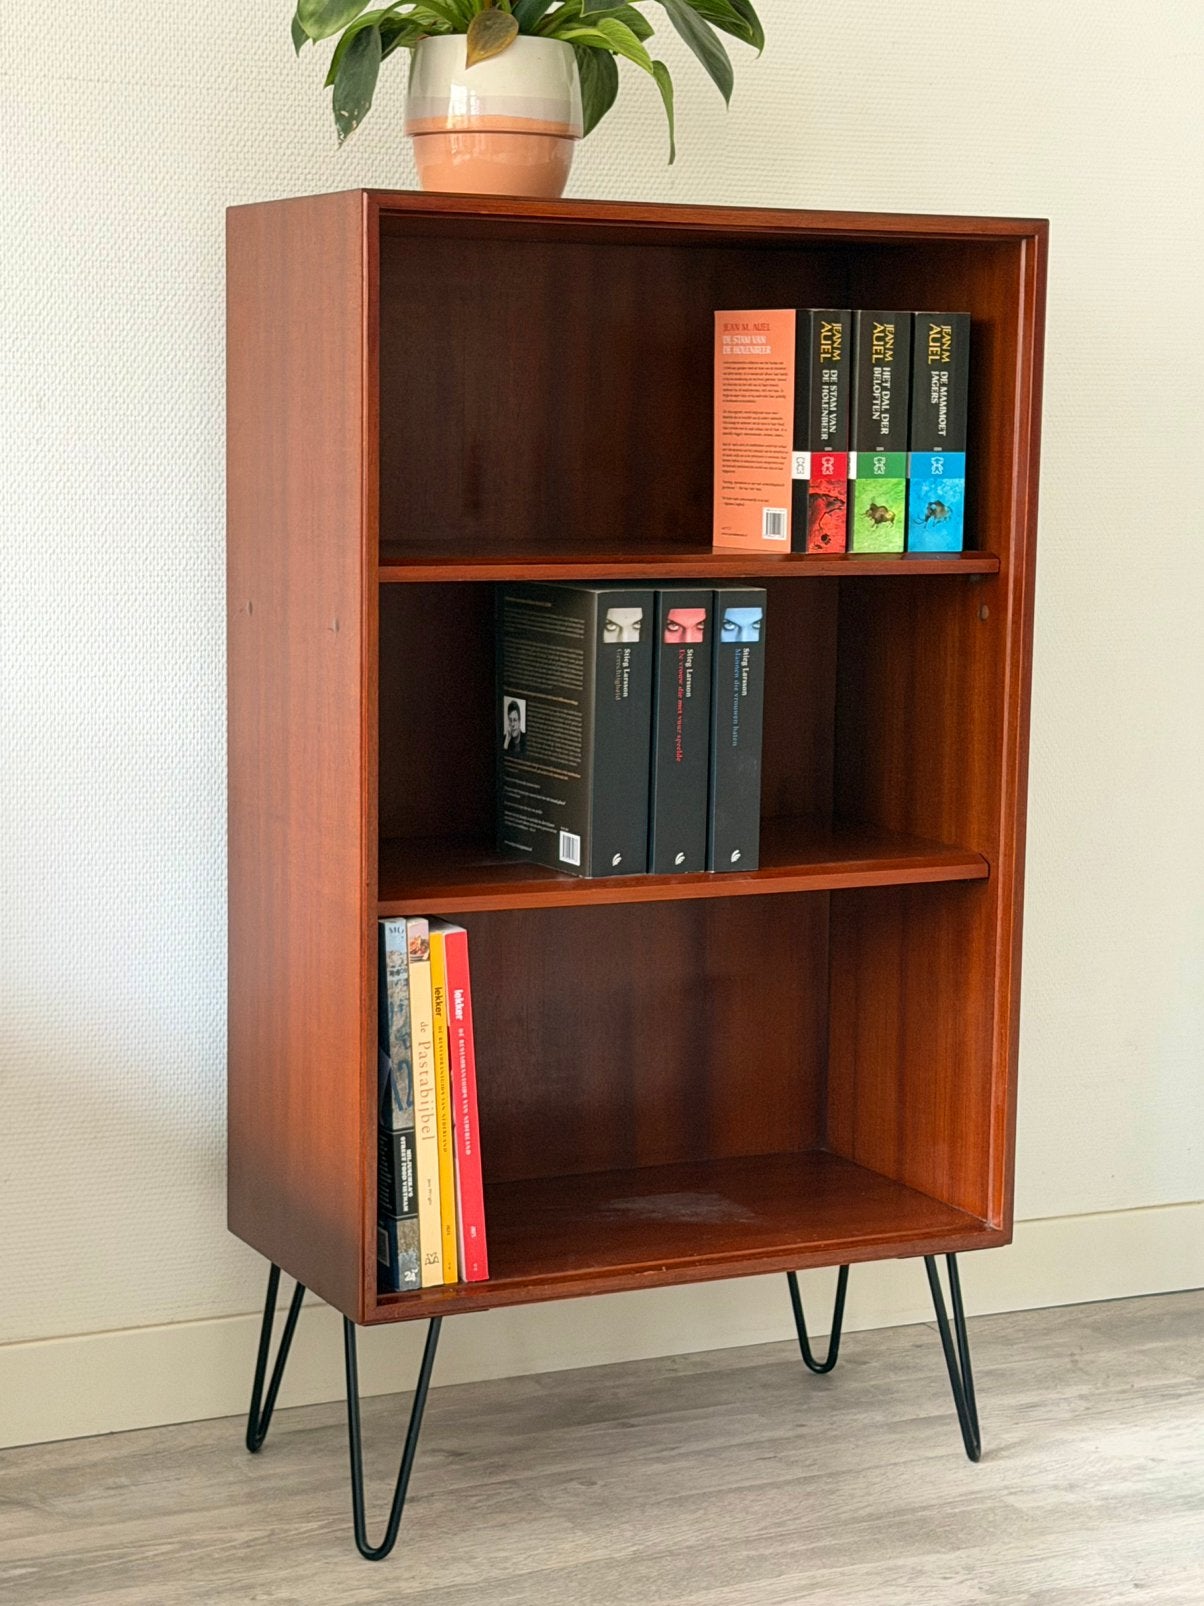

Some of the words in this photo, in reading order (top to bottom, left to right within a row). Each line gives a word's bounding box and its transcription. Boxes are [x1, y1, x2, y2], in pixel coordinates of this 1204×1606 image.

[820, 321, 833, 363] AUEL
[832, 323, 842, 348] JEAN
[872, 322, 885, 363] AUEL
[884, 324, 895, 348] JEAN
[928, 324, 941, 364] AUEL
[941, 325, 951, 350] JEAN
[832, 350, 841, 361] M
[884, 350, 894, 362] M
[941, 352, 951, 362] M
[822, 369, 830, 383] DE
[830, 369, 838, 383] DE
[882, 367, 891, 388] HET
[930, 371, 939, 404] JAGERS
[940, 371, 949, 385] DE
[829, 385, 838, 410] STAM
[872, 367, 882, 420] BELOFTEN
[881, 390, 891, 411] DAL
[820, 385, 830, 440] HOLENBEER
[829, 413, 837, 433] VAN
[880, 413, 890, 435] DER
[938, 387, 948, 436] MAMMOET
[622, 648, 631, 667] Stieg
[685, 648, 694, 667] Stieg
[741, 647, 750, 666] Stieg
[622, 669, 631, 698] Larsson
[685, 669, 693, 698] Larsson
[741, 668, 749, 696] Larsson
[434, 987, 443, 1016] lekker
[454, 989, 465, 1020] lekker
[420, 1021, 429, 1033] de
[417, 1040, 435, 1141] Pastabijbel
